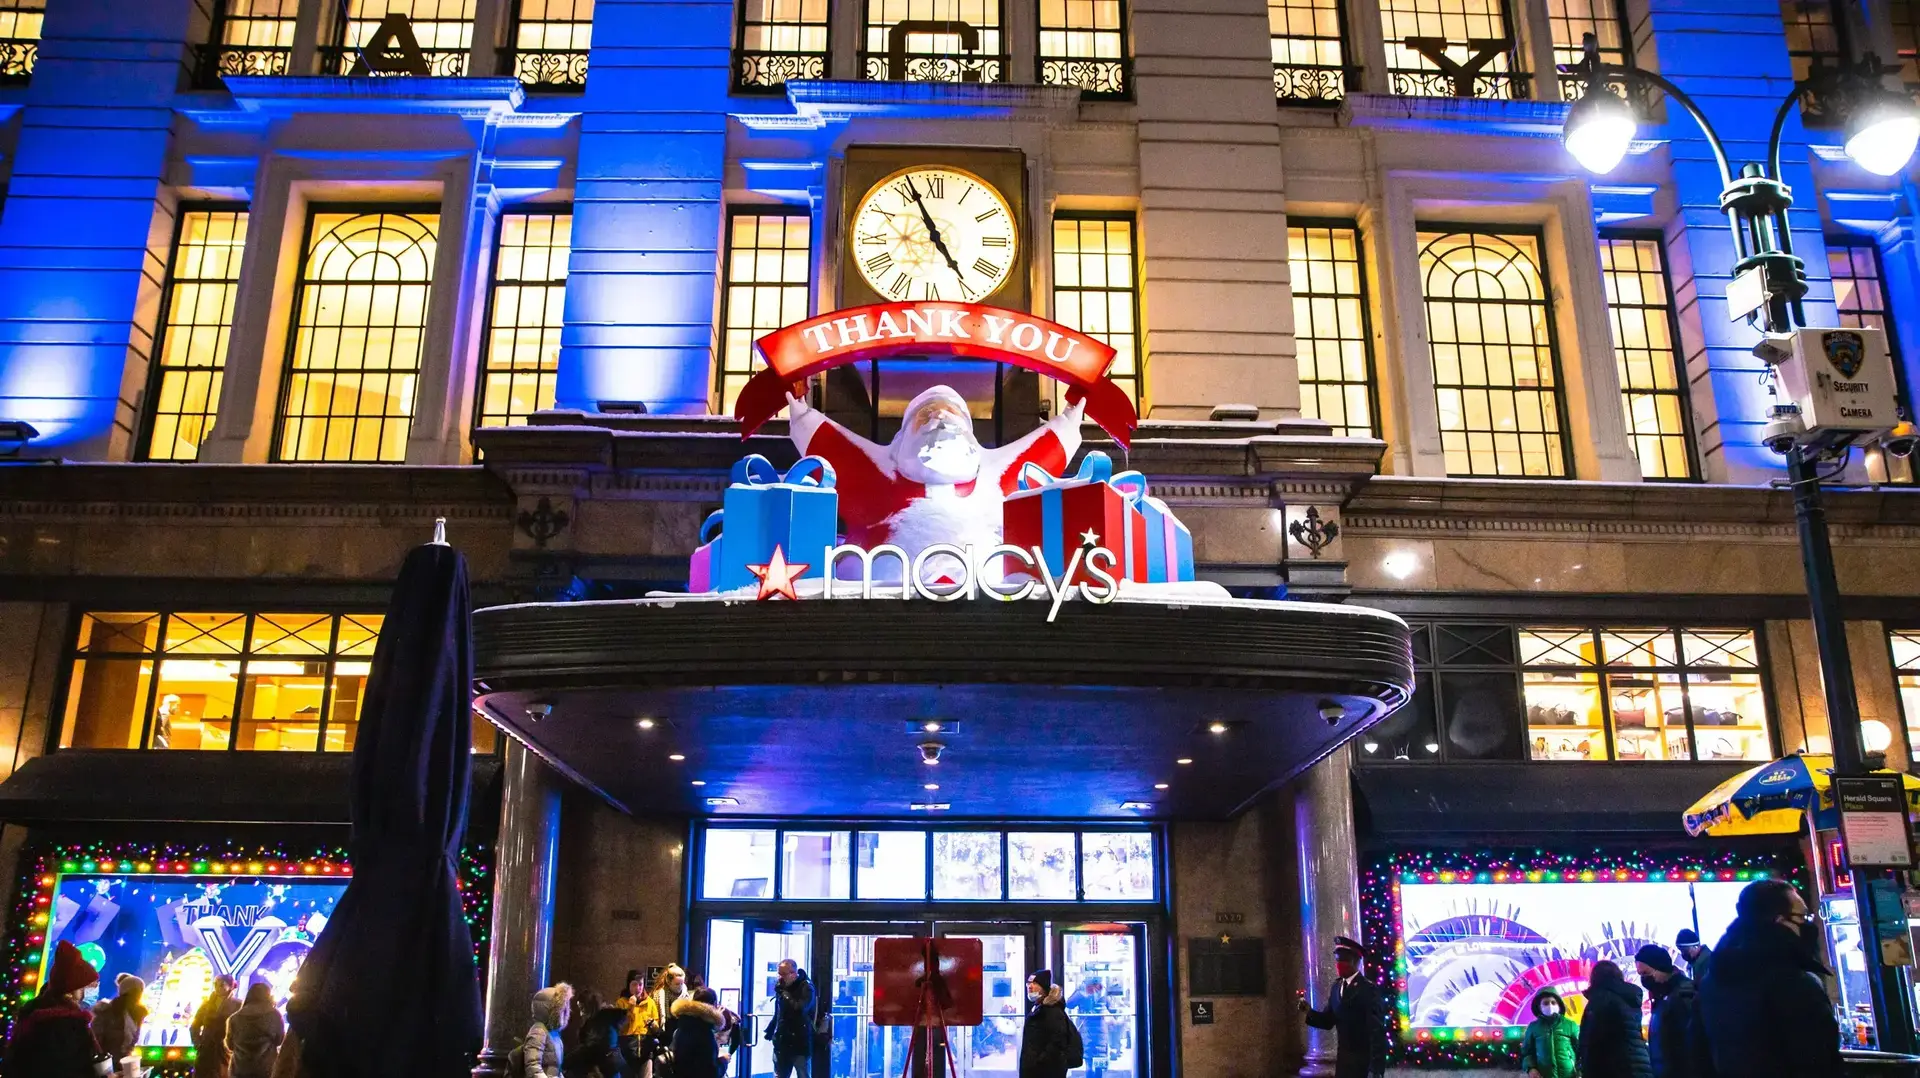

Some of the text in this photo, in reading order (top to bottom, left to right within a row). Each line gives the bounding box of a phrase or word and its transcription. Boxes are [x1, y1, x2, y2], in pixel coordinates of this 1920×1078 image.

[926, 178, 944, 199] XII
[803, 308, 1080, 363] THANK YOU
[1833, 381, 1869, 393] SECURITY
[1840, 407, 1873, 418] CAMERA
[1843, 794, 1893, 803] Herald Square
[182, 904, 271, 927] THANK
